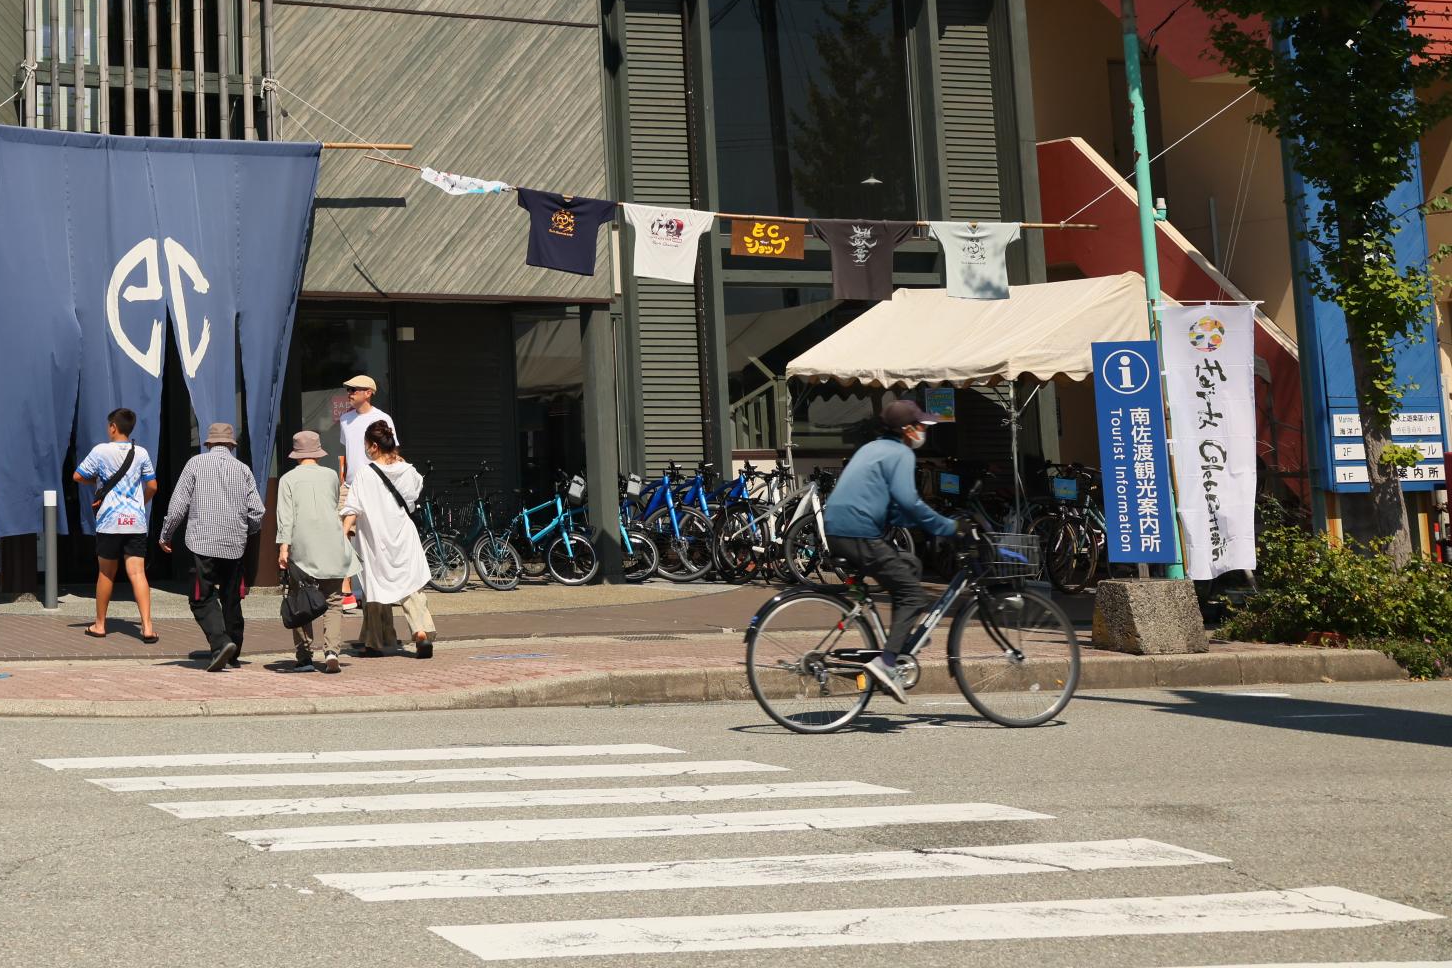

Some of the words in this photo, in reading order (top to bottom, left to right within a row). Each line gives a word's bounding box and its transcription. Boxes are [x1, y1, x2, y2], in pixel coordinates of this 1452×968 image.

[744, 236, 790, 255] ショップ
[753, 222, 780, 238] EC
[1110, 408, 1126, 460] Tourist
[1129, 407, 1161, 553] 南佐渡観光案内所
[1343, 472, 1354, 481] 1F
[1115, 466, 1131, 552] Information
